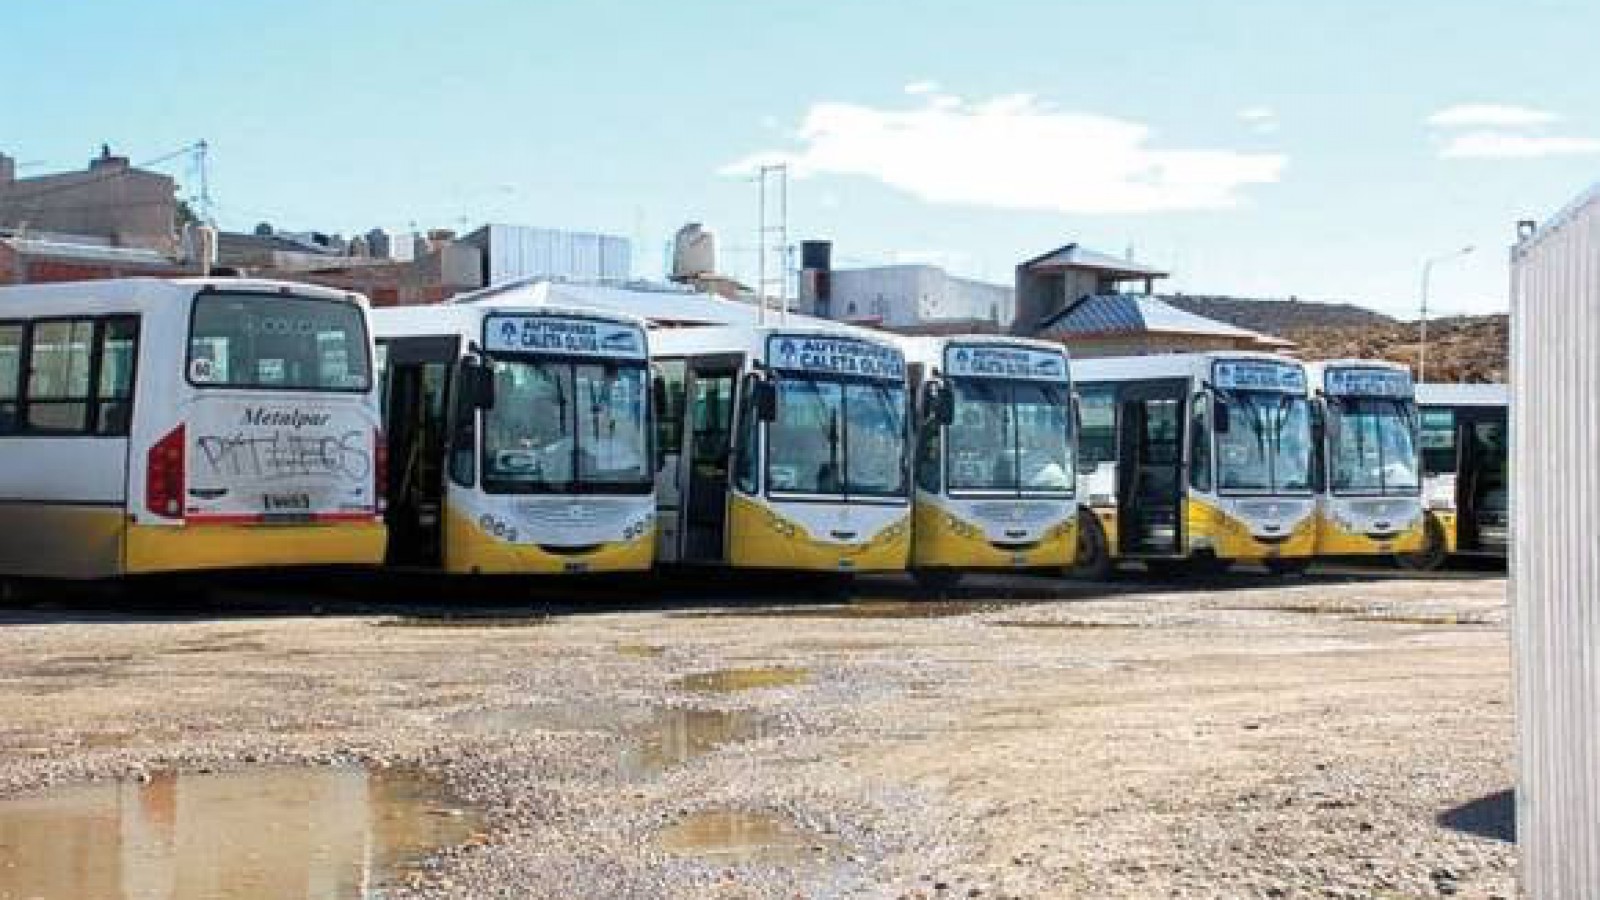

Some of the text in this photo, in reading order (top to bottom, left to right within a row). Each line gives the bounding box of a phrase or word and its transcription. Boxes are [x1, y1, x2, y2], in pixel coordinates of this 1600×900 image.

[521, 331, 562, 348] CALETA
[800, 352, 857, 371] CALETA
[241, 408, 331, 429] Metalpar
